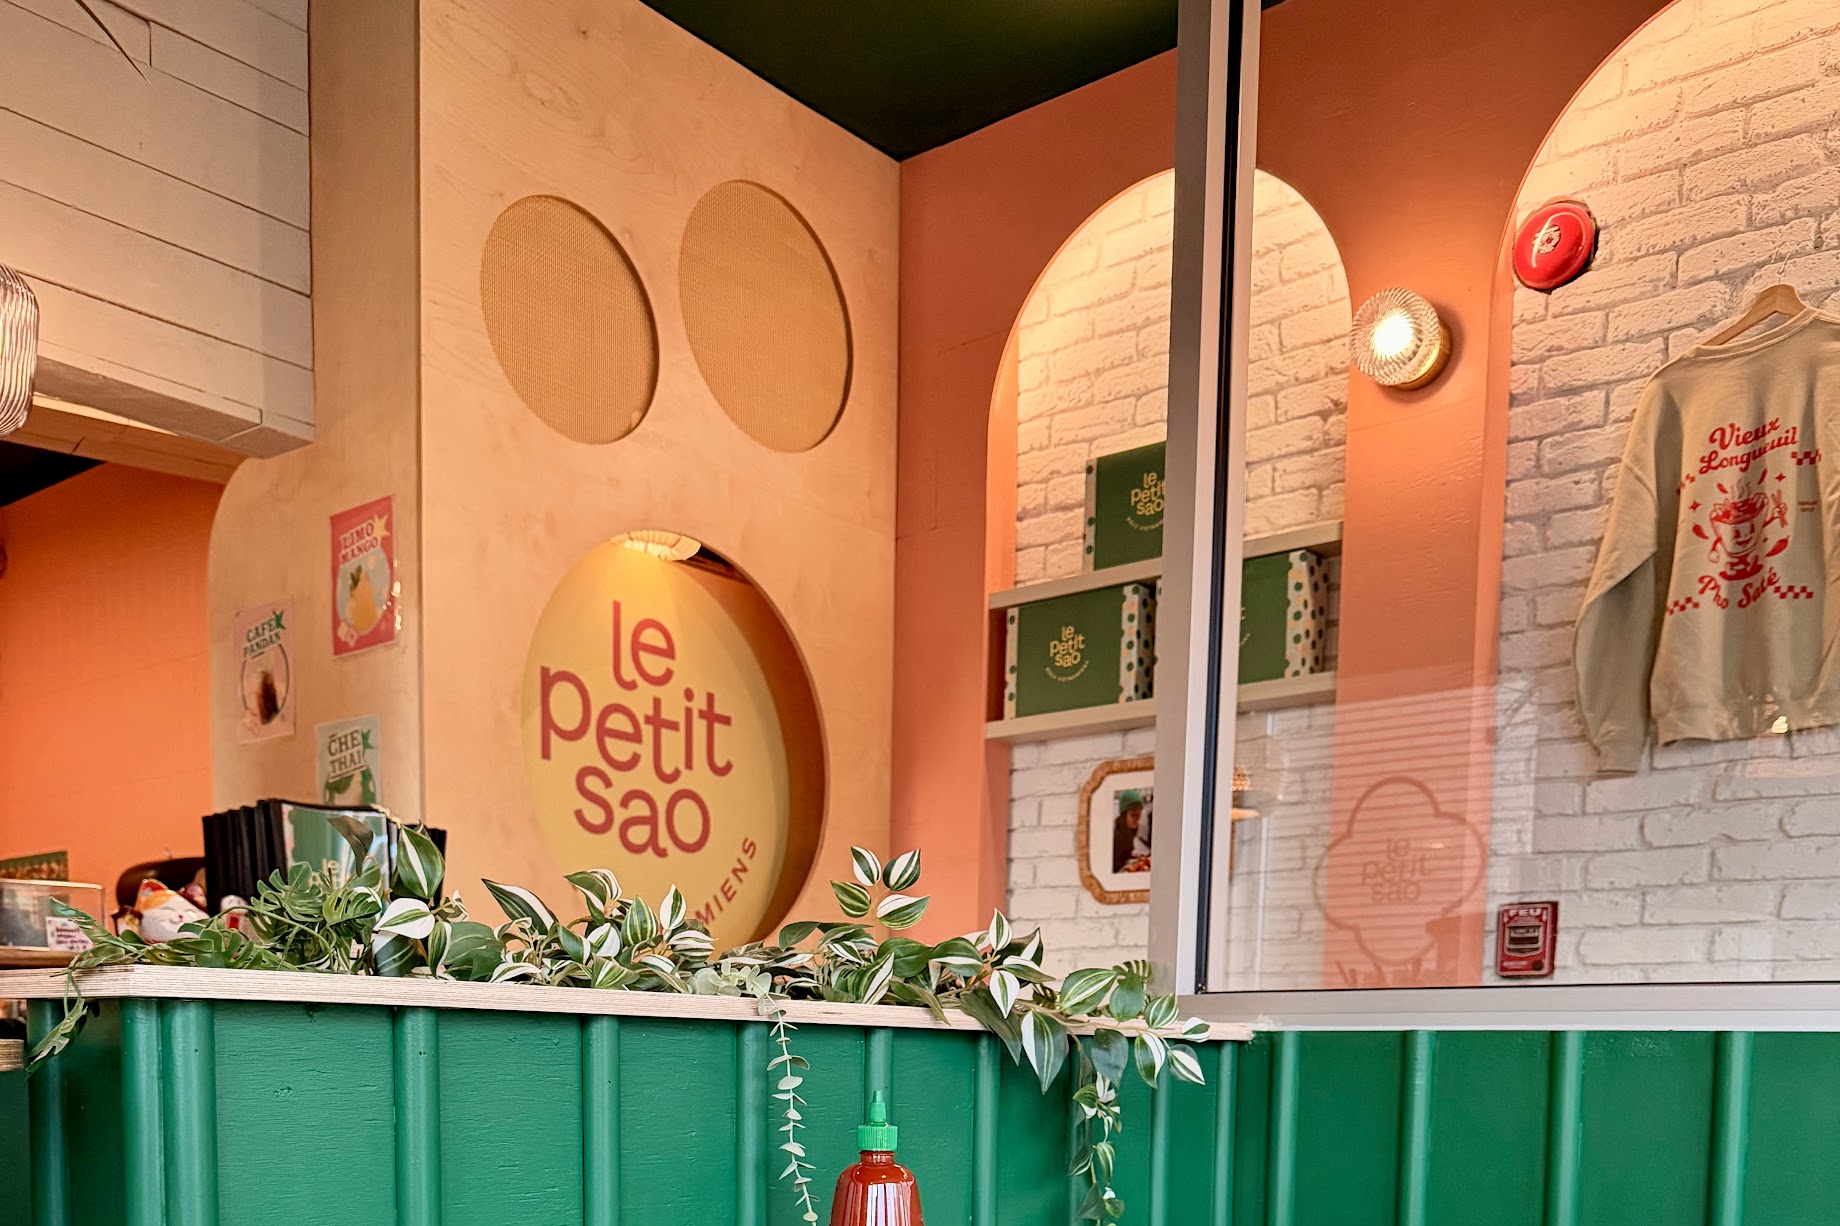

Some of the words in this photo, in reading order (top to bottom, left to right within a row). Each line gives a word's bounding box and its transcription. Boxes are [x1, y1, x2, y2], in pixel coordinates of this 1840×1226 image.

[1709, 417, 1780, 450] Vieux
[1699, 426, 1798, 474] Longueuil
[1130, 480, 1166, 507] peti
[1143, 472, 1158, 489] le
[1136, 499, 1165, 516] sao
[342, 521, 375, 550] LIMO
[340, 536, 379, 565] MANGO
[1698, 574, 1730, 610] Pho
[242, 631, 281, 658] PANDAN
[612, 600, 676, 692] le
[1049, 634, 1086, 657] petit
[1061, 625, 1075, 642] le
[1054, 651, 1082, 668] sao
[540, 665, 734, 785] petit
[330, 754, 363, 775] THAI
[574, 765, 711, 859] sao
[694, 836, 757, 926] MIENS
[1361, 855, 1432, 886] petit
[1371, 881, 1422, 904] sao
[1508, 907, 1542, 918] FEU
